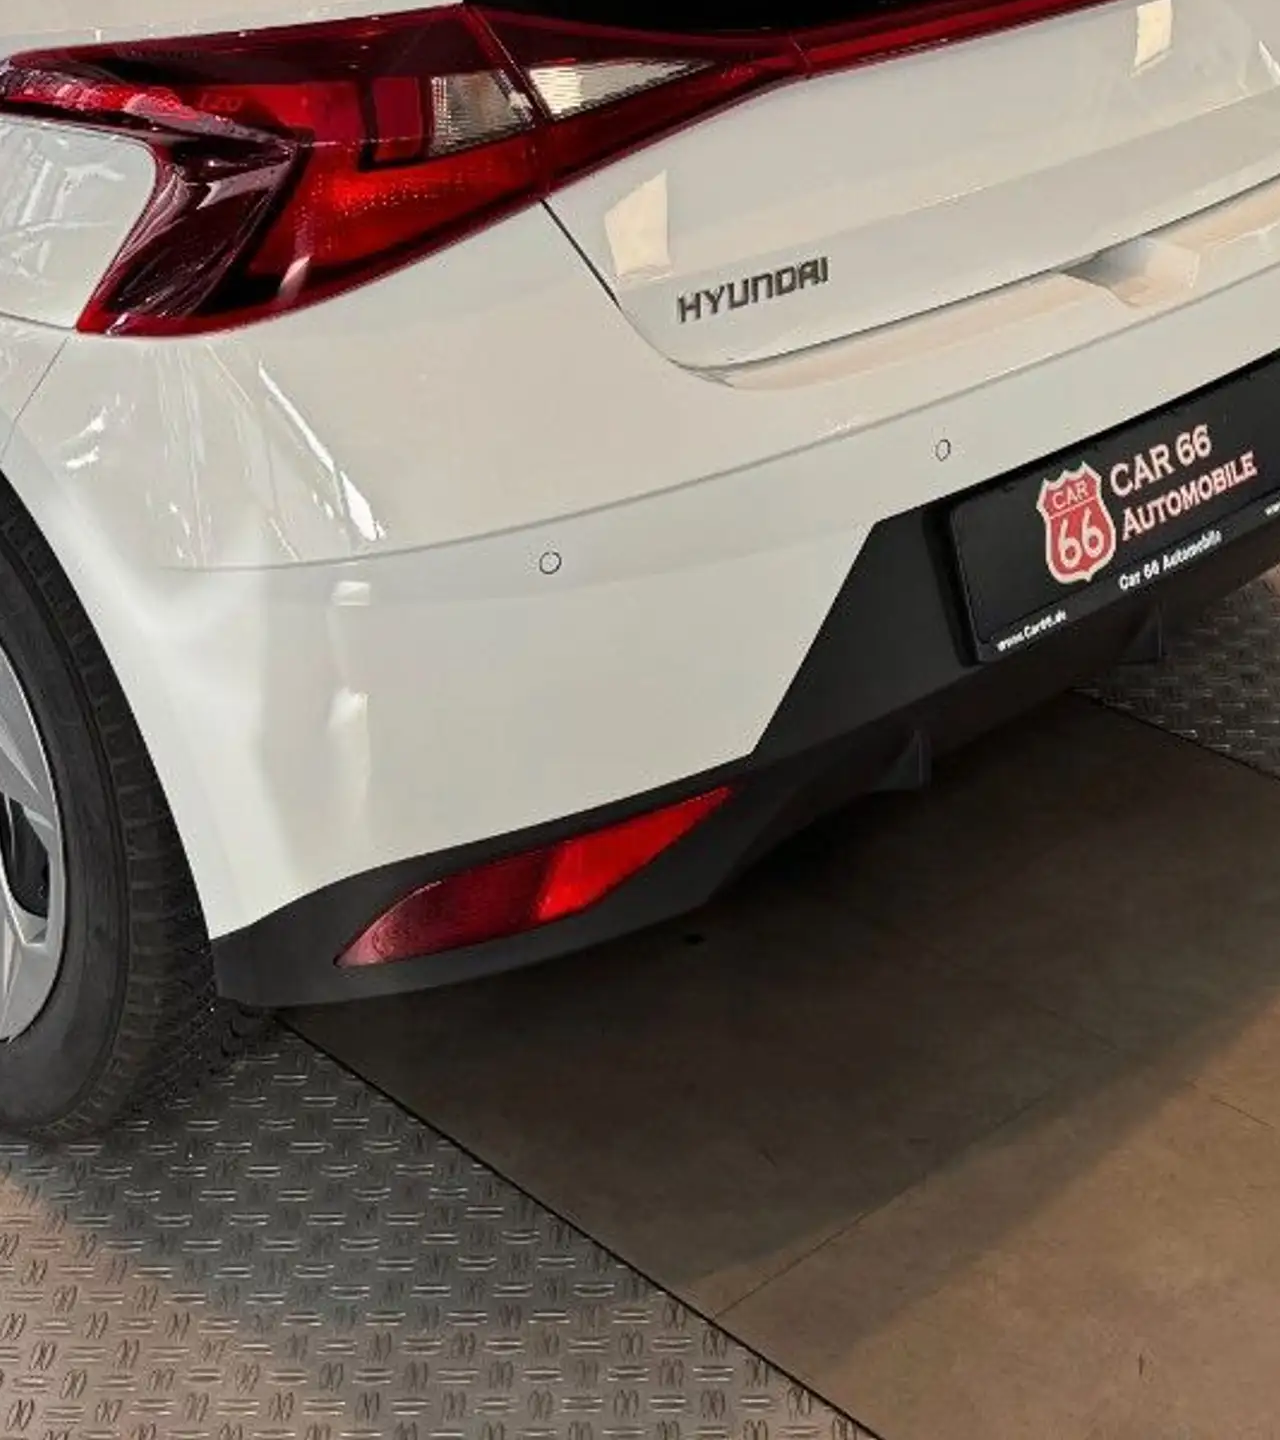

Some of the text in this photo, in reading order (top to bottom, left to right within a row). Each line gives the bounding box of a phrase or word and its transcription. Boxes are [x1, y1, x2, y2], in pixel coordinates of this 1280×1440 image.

[677, 256, 829, 323] HYUNDAI
[1110, 423, 1212, 497] CAR 66
[1052, 480, 1090, 509] CAR
[1122, 450, 1258, 541] AUTOMOBILE
[1058, 506, 1105, 568] 66
